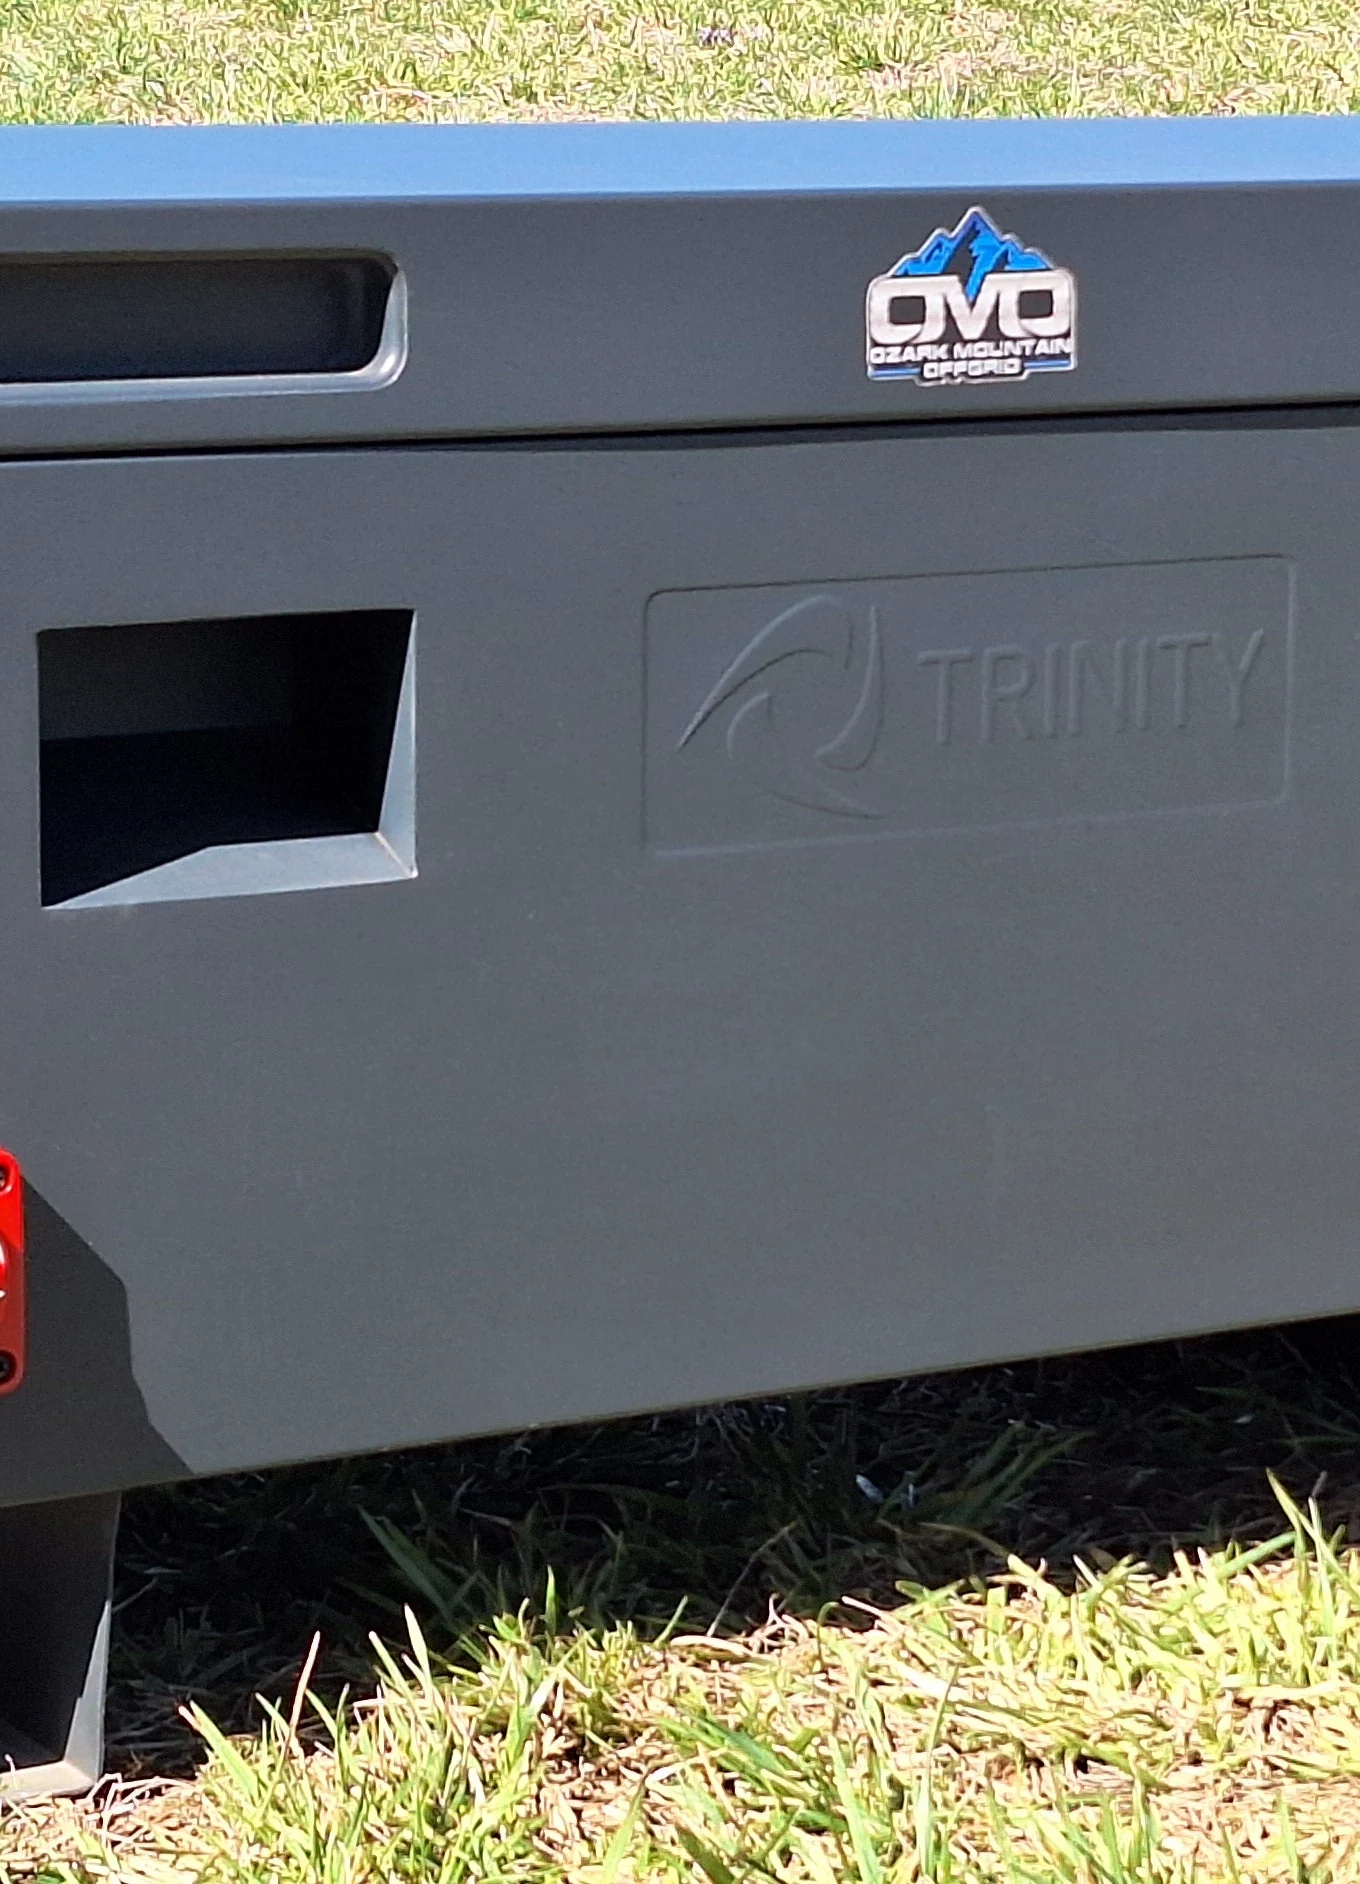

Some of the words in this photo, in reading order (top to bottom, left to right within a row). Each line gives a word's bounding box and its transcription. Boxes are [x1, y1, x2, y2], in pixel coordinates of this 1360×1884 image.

[870, 343, 949, 364] OZARK
[953, 338, 1071, 359] MOUNTAIN
[923, 358, 1022, 379] OFFGRID
[917, 628, 1264, 746] TRINITY
